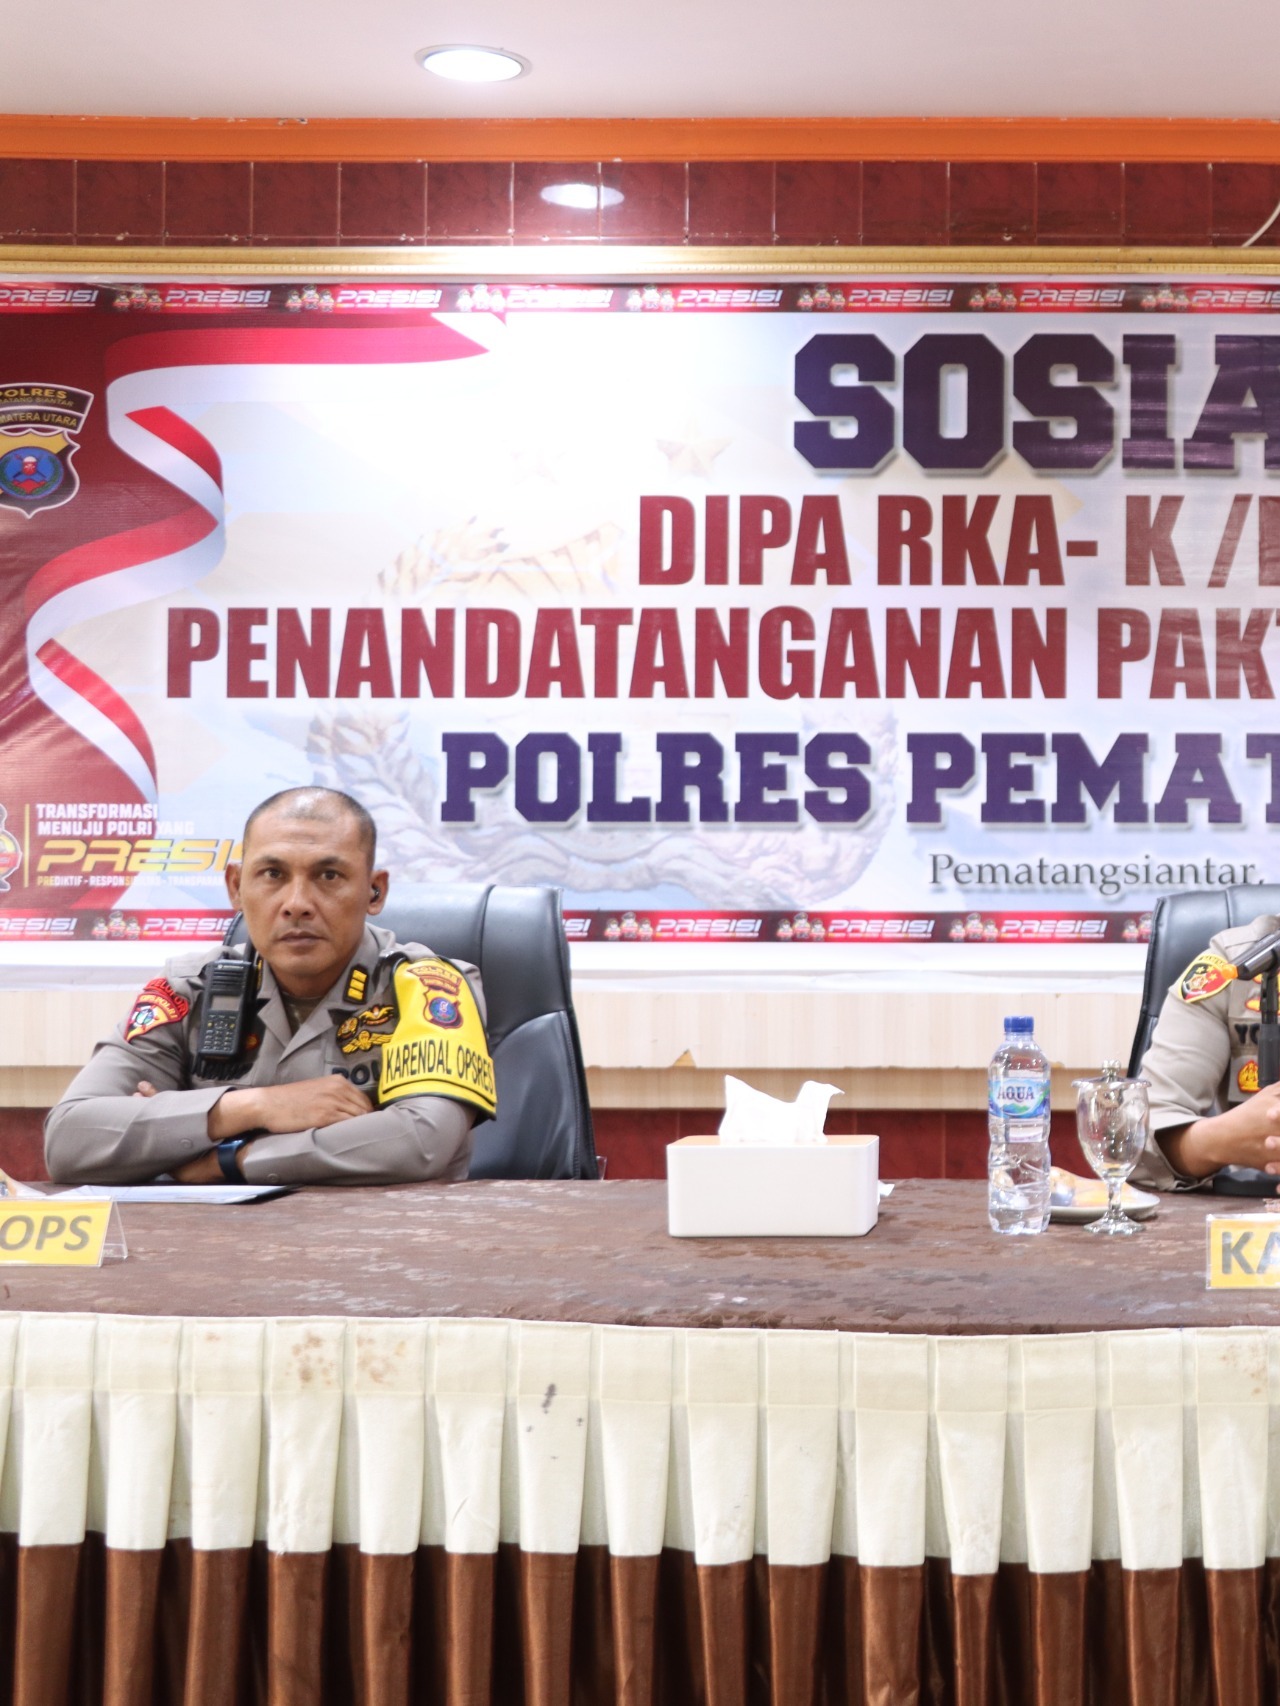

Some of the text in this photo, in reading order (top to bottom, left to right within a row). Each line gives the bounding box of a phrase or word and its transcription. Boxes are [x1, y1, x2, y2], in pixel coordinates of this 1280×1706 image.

[165, 290, 271, 303] PRESISI
[337, 289, 442, 303] PRESISI
[677, 289, 783, 303] PRESISI
[849, 289, 954, 302] PRESISI
[1020, 289, 1125, 302] PRESISI
[0, 412, 78, 427] MATERA UTARA
[638, 495, 851, 586] DIPA
[876, 495, 1099, 586] RKA-
[167, 606, 1067, 701] PENANDATANGANAN
[441, 732, 872, 823] POLRES
[36, 803, 158, 819] TRANSFORMASI
[38, 821, 195, 835] MENUJU POLRI YANG
[36, 838, 243, 872] PRESI
[37, 875, 83, 887] PREDIKTIF
[0, 917, 78, 930] RESISI
[143, 917, 233, 930] PRESI
[656, 919, 762, 932] PRESISI
[828, 919, 935, 932] PRESISI
[1001, 920, 1107, 933] PRESISI
[385, 1039, 494, 1095] KARENDAL OPSRES
[997, 1085, 1035, 1103] AQUA
[0, 1214, 92, 1251] OPS
